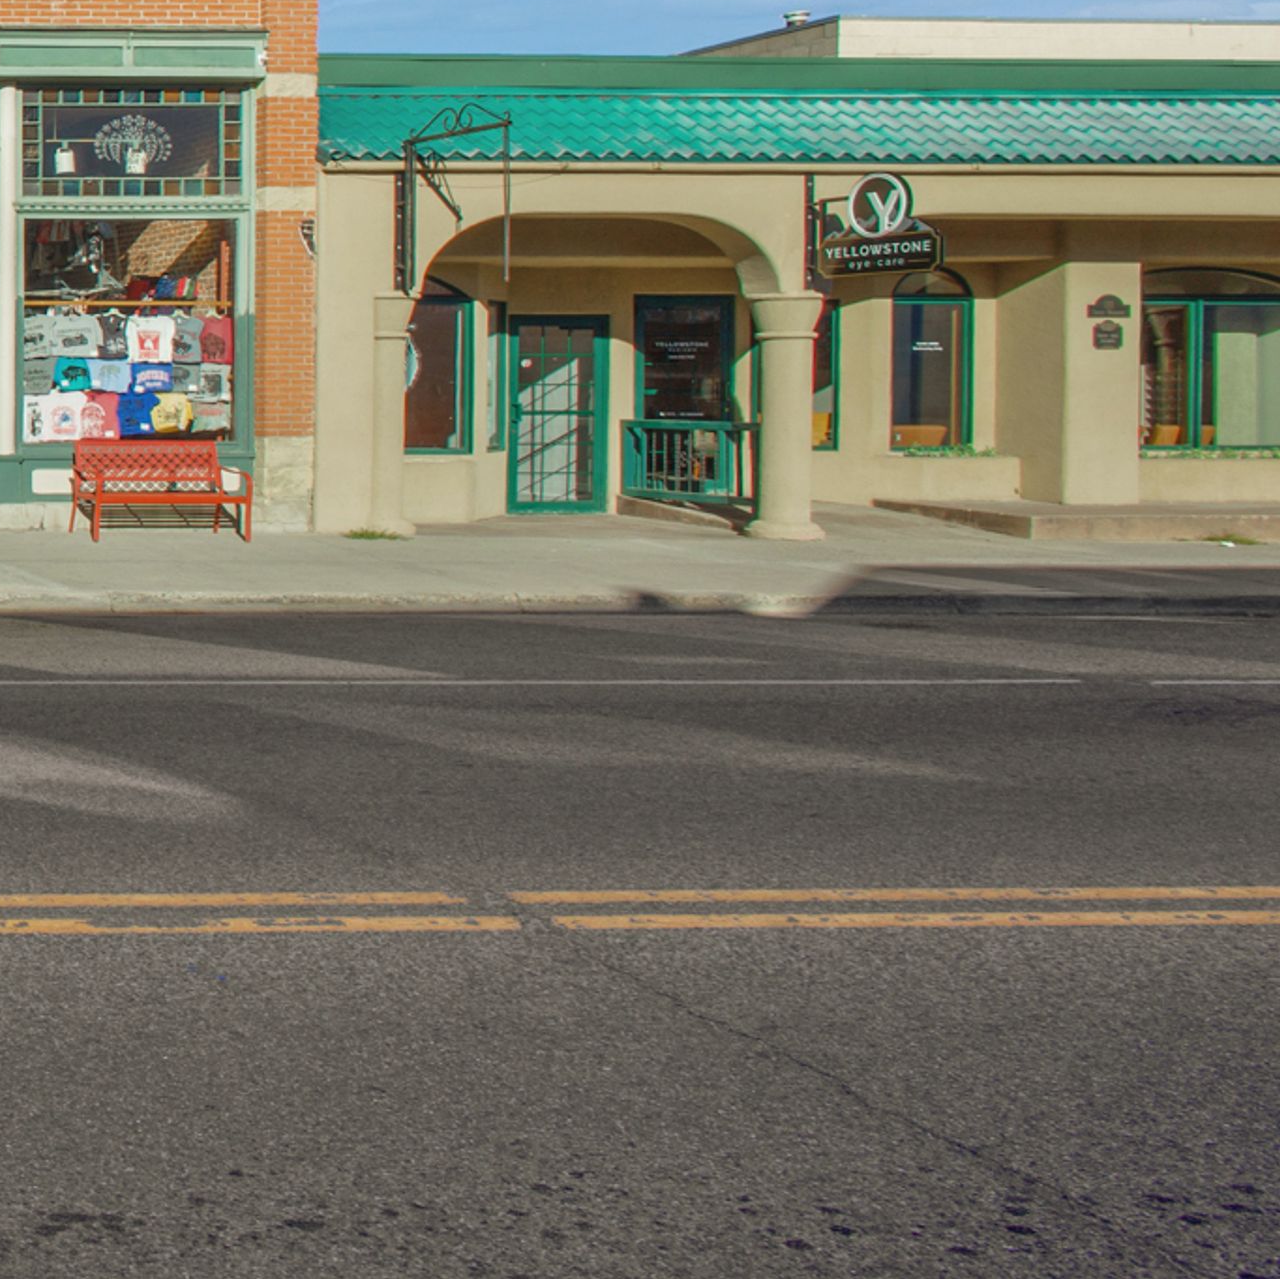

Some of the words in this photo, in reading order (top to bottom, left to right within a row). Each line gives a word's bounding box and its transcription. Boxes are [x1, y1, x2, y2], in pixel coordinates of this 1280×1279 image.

[825, 240, 932, 259] YELLOWSTONE
[848, 260, 870, 270] eye
[877, 257, 905, 266] care
